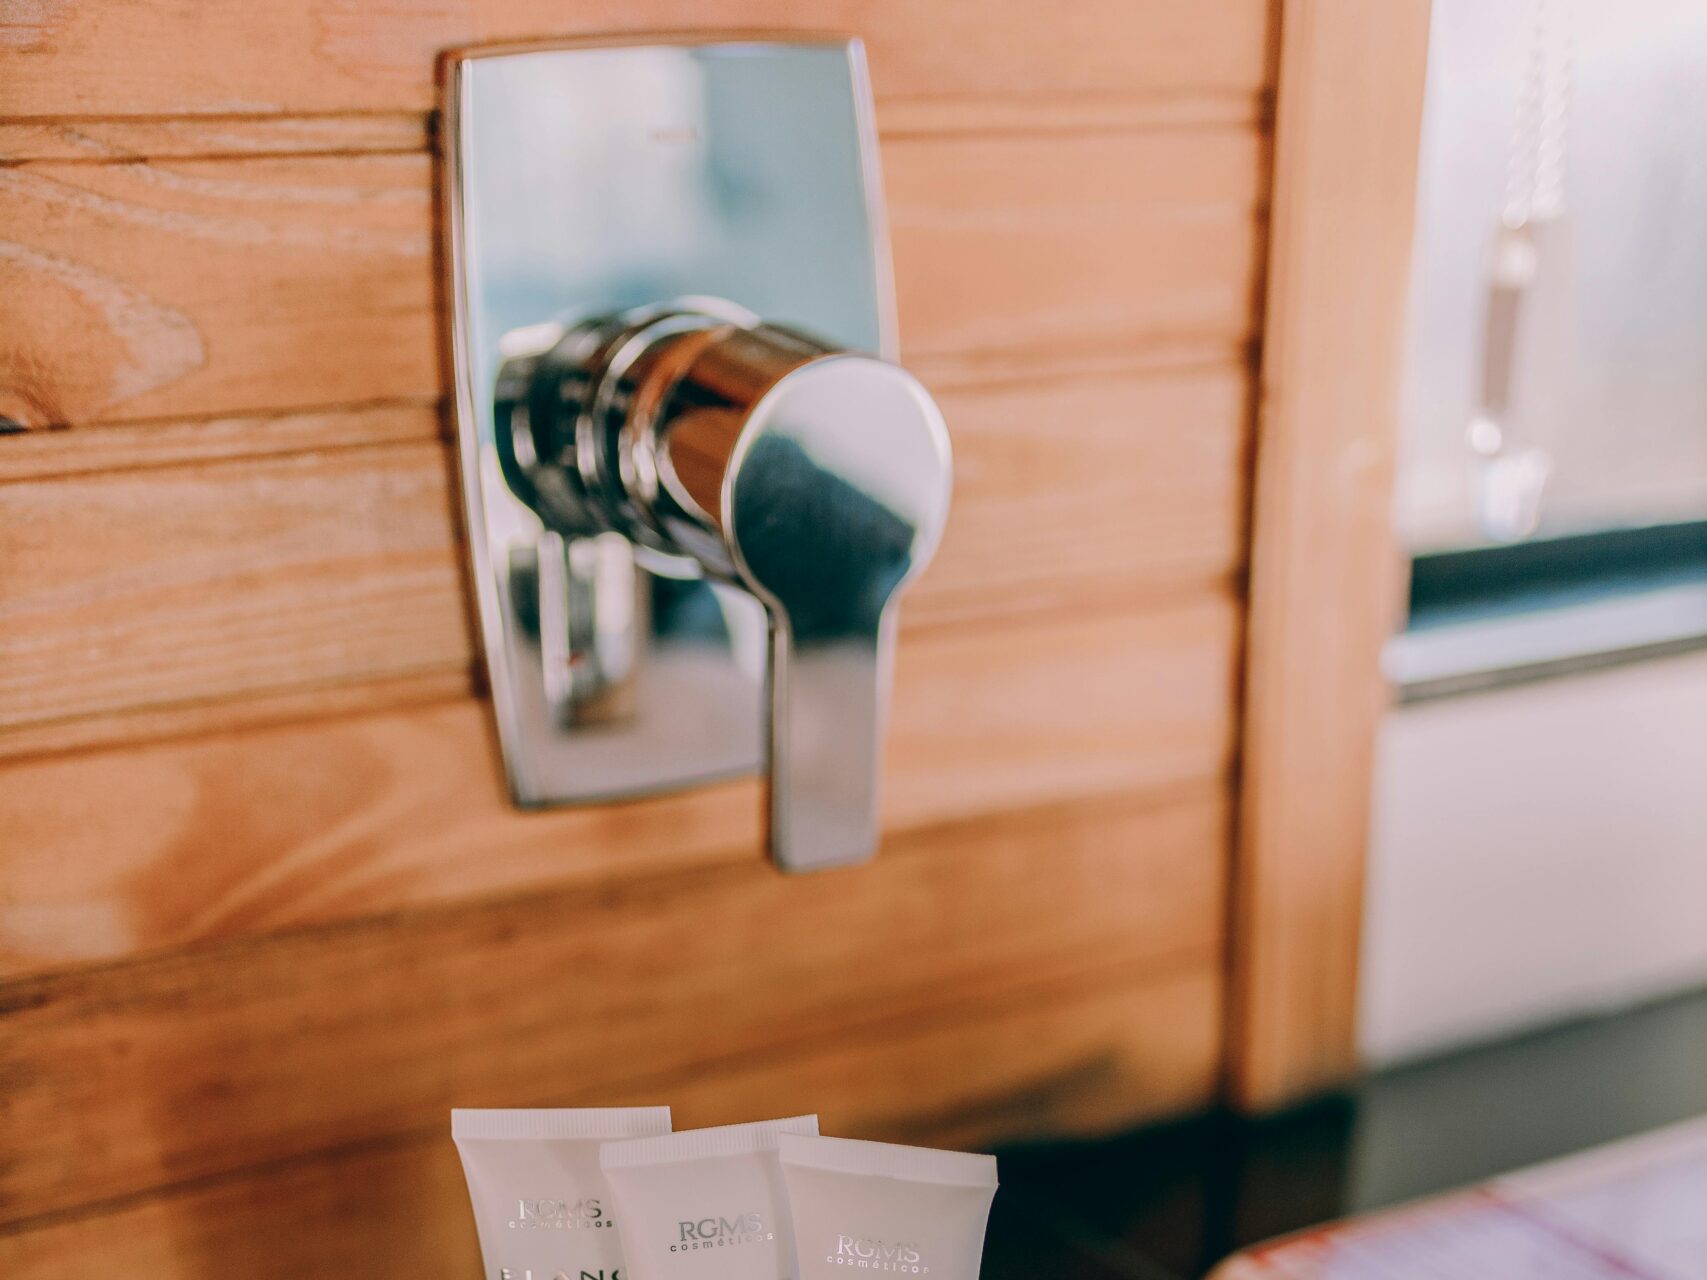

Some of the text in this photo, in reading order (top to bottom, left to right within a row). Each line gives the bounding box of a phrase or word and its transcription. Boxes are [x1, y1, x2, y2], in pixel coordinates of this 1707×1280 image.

[678, 1213, 763, 1242] RGMS
[670, 1232, 774, 1252] cosméticos
[837, 1234, 920, 1263] RGMS
[826, 1255, 930, 1274] cosméticos
